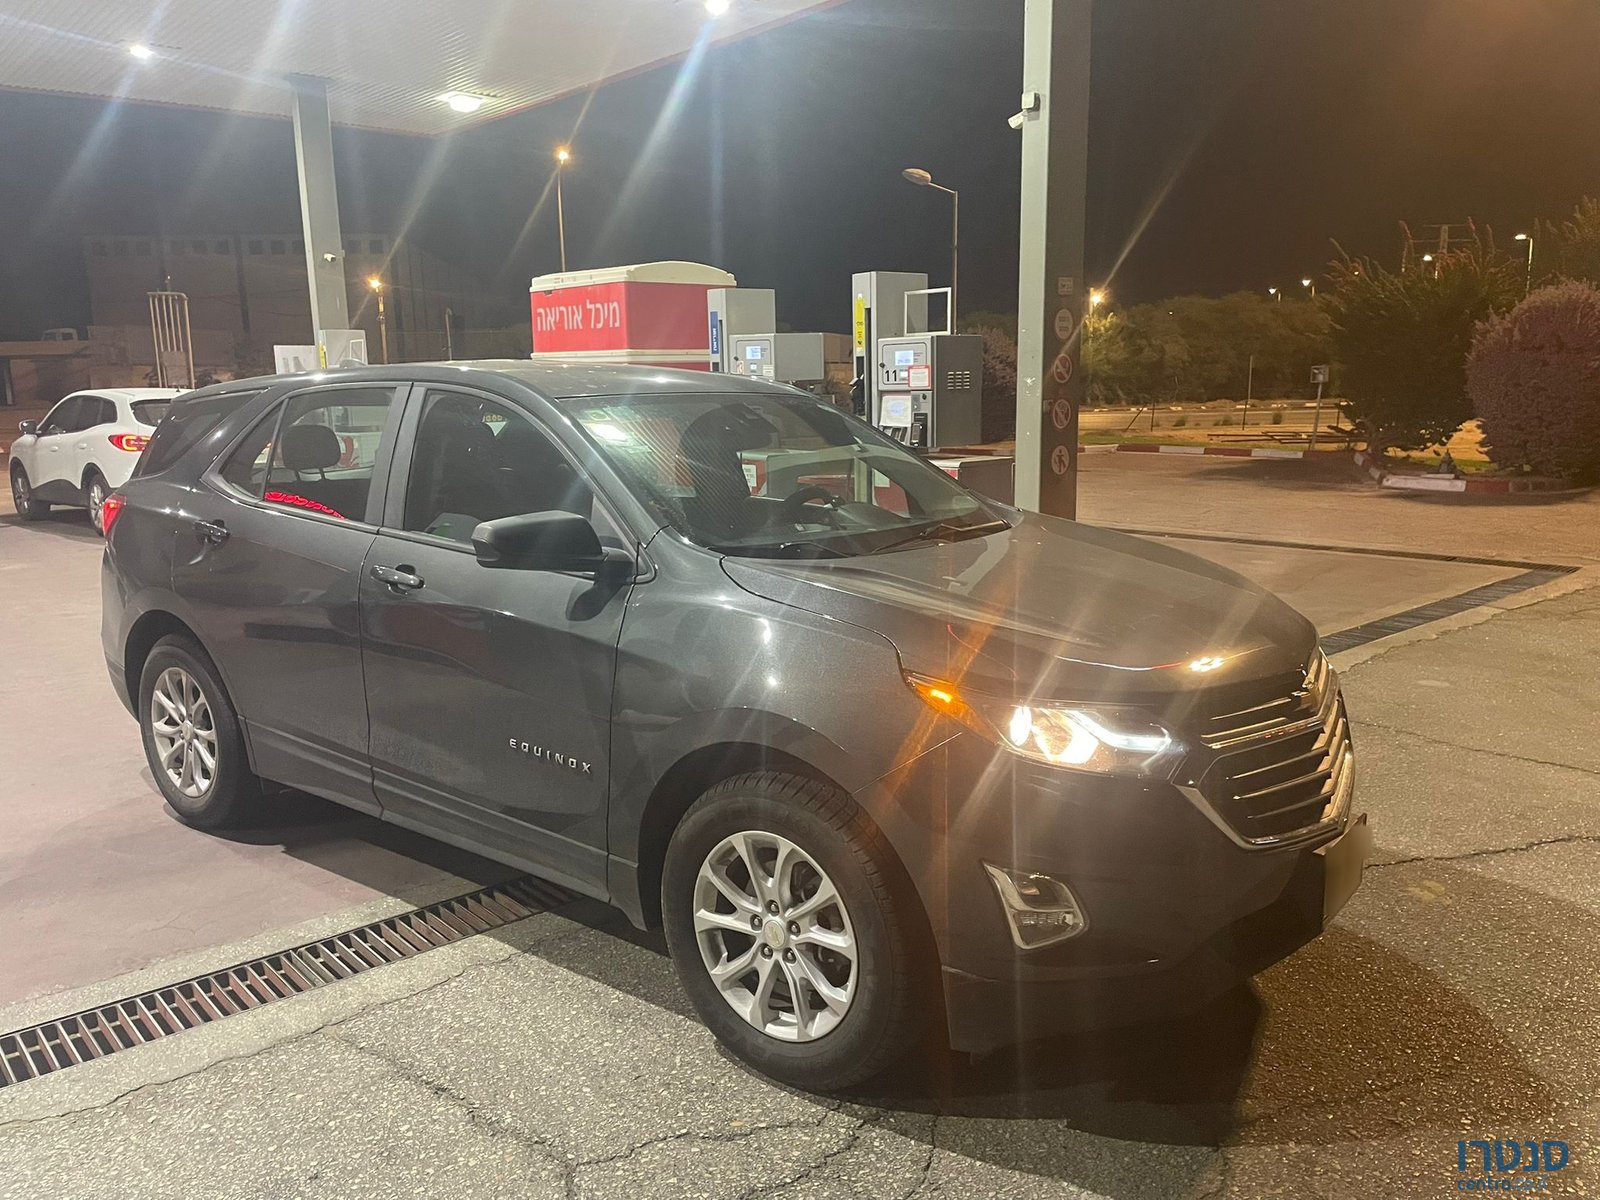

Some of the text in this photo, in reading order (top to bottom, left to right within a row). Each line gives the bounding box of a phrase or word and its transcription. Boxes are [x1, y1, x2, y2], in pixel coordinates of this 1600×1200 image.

[536, 299, 620, 332] מיכל אוריאה
[886, 369, 897, 382] 11
[509, 738, 592, 774] EQUINOX
